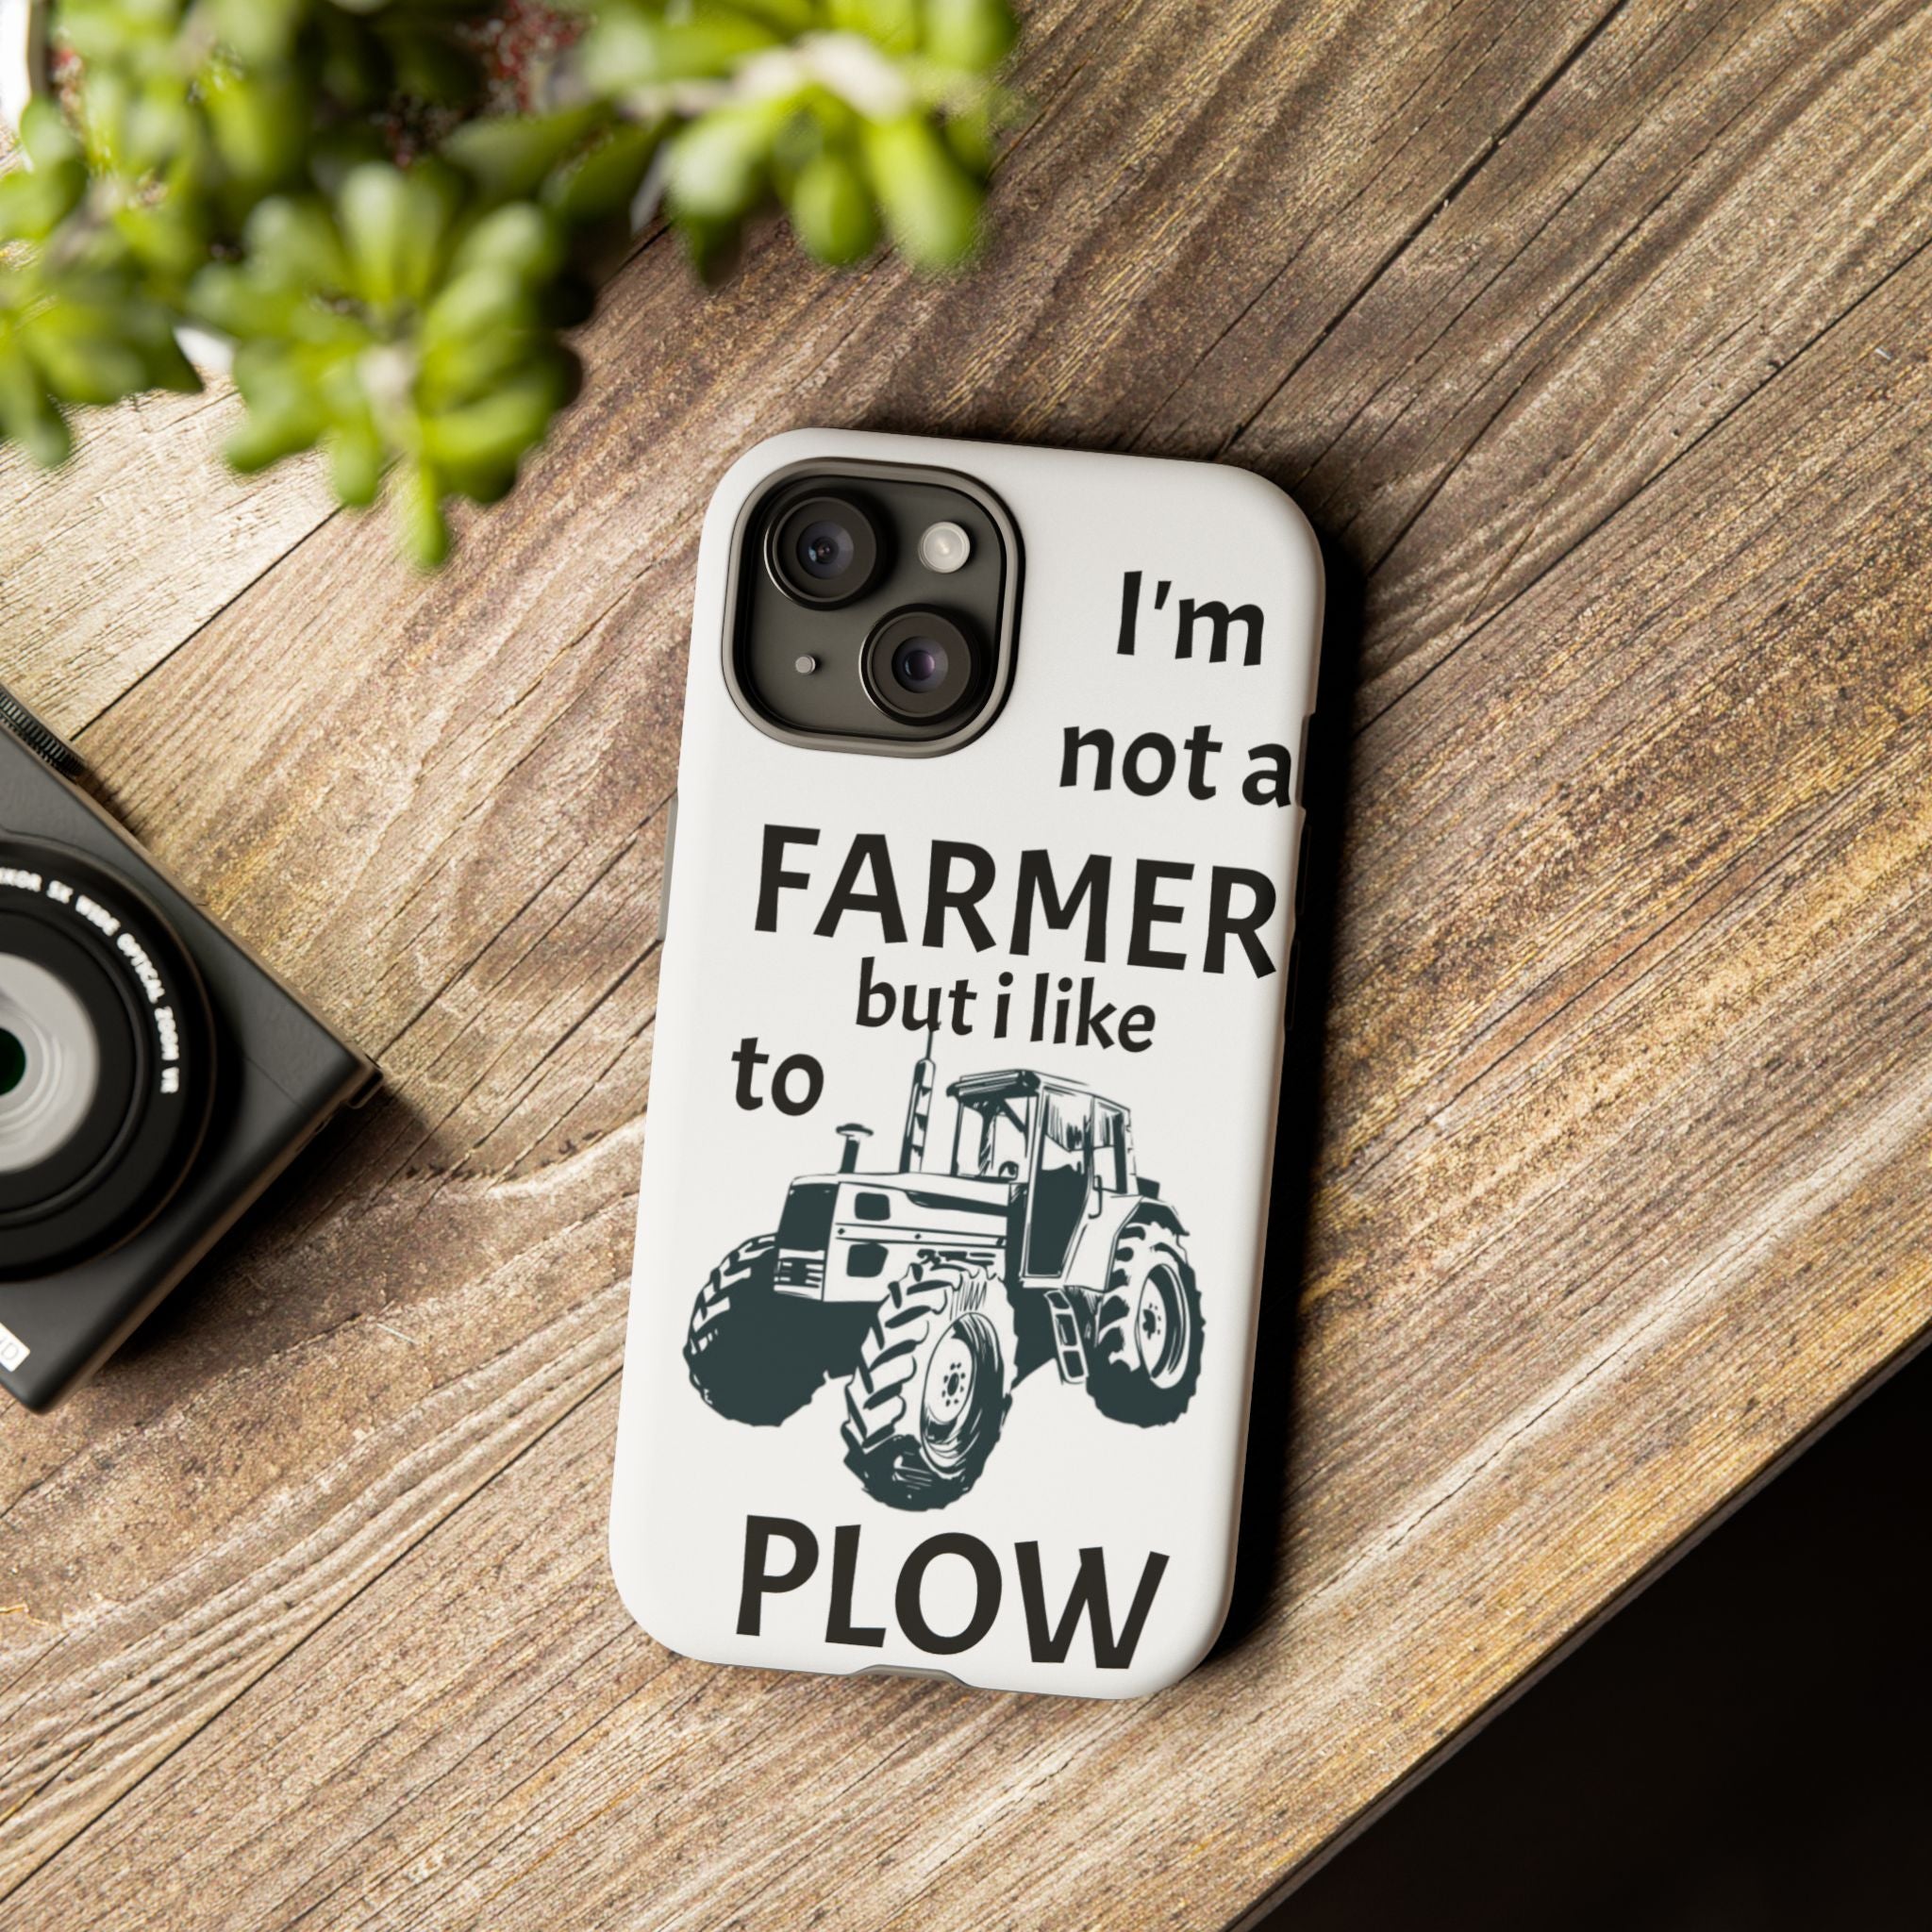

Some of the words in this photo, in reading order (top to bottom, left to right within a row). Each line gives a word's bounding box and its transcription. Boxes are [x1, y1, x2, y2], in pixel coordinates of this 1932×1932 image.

[1116, 570, 1265, 667] I'm
[1059, 724, 1224, 801] not
[1241, 743, 1292, 808] a
[755, 824, 1277, 979] FARMER
[75, 895, 121, 937] WIDE
[116, 933, 165, 1004] OPTICAL
[154, 1006, 179, 1061] ZOOM
[856, 956, 977, 1036] but
[993, 971, 1014, 1039] i
[1030, 973, 1157, 1053] like
[731, 1037, 824, 1117] to
[736, 1514, 1171, 1670] PLOW
